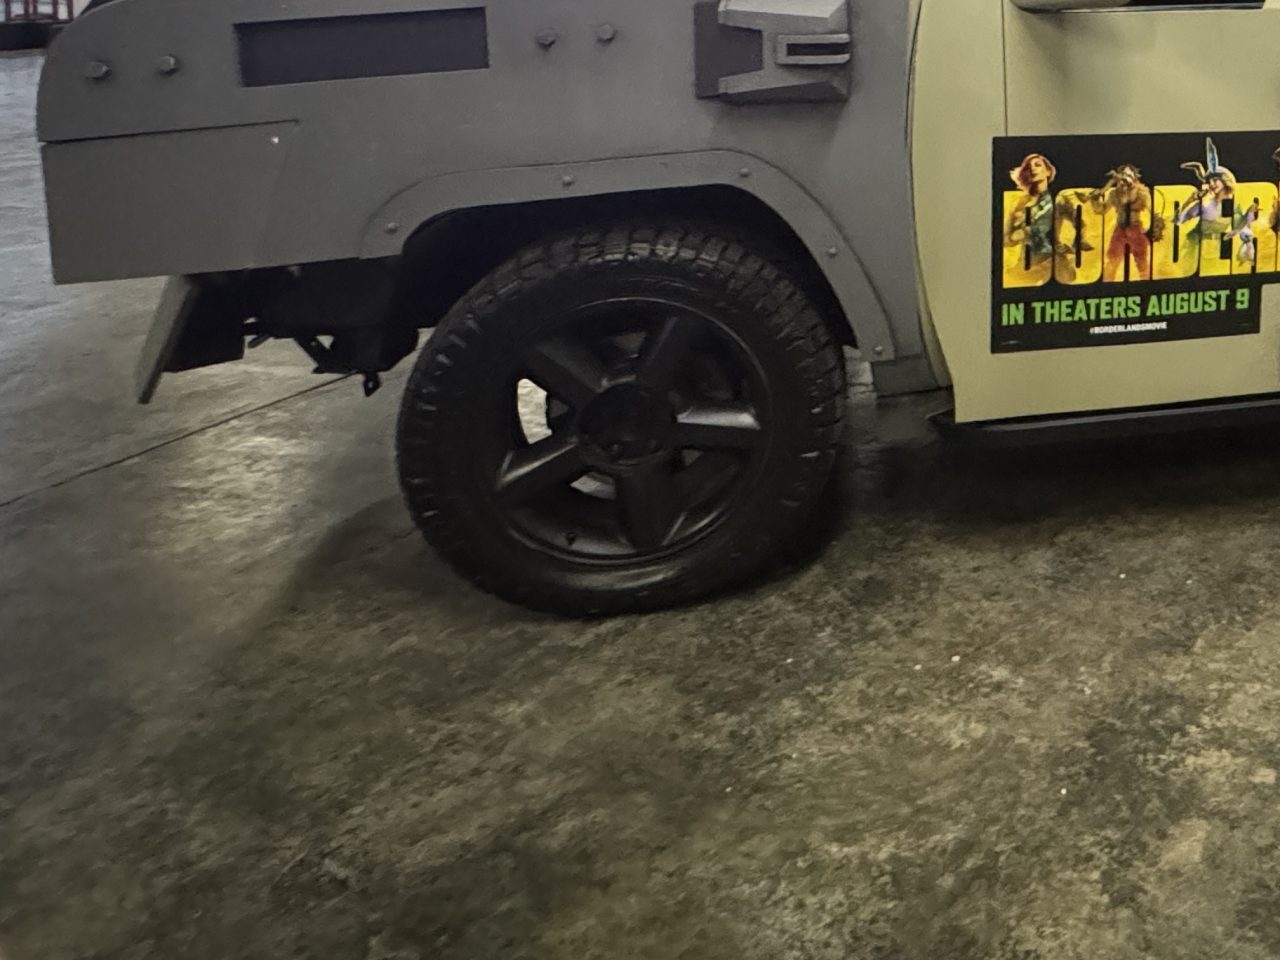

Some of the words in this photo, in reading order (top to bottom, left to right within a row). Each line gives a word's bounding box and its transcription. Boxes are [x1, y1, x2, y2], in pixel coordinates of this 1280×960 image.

[1001, 303, 1025, 326] IN
[1031, 294, 1141, 324] THEATERS
[1146, 289, 1231, 317] AUGUST
[1235, 288, 1250, 310] 9
[1089, 321, 1168, 334] #BORDERLANDSMOVIE
